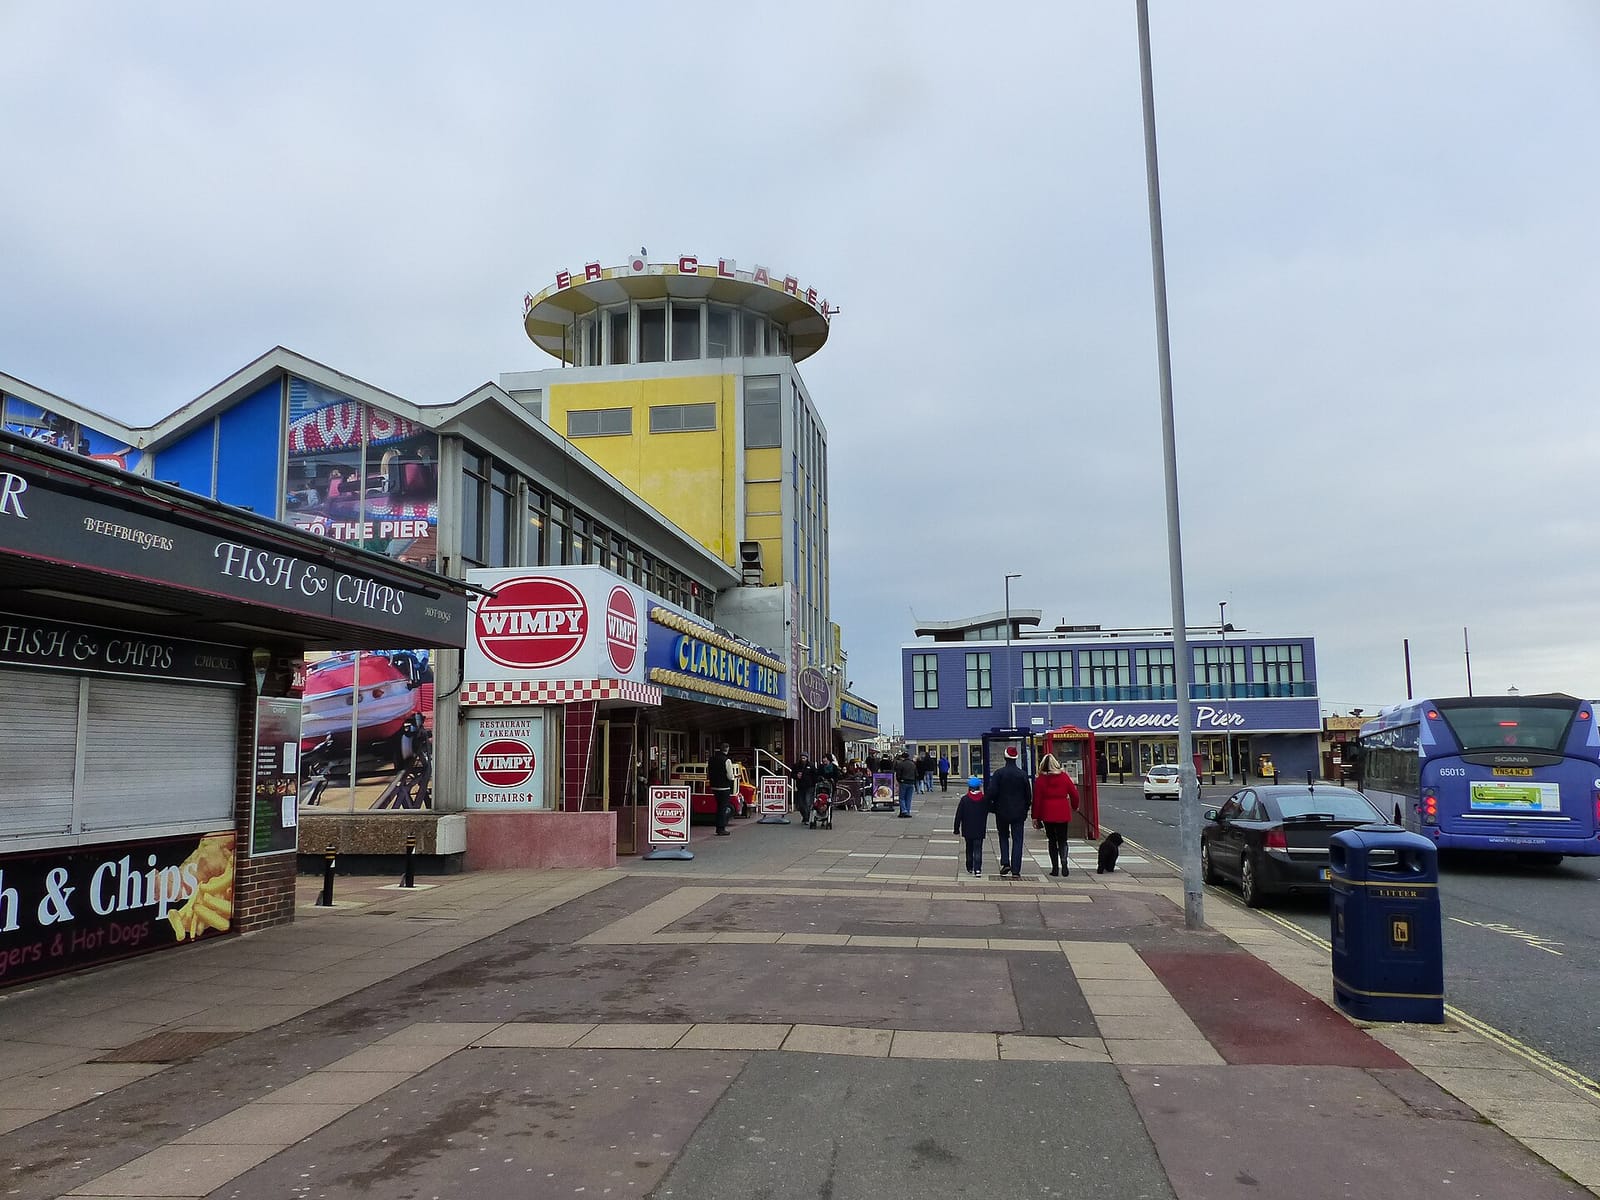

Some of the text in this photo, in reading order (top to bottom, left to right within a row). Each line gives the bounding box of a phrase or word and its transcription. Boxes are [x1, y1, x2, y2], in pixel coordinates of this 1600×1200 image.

[332, 522, 373, 539] THE
[380, 521, 429, 538] PIER
[84, 517, 174, 550] BEEFBURGERS
[214, 542, 298, 590] FISH
[300, 565, 328, 596] &
[336, 574, 405, 615] CHIPS
[480, 610, 583, 635] WIMPY
[607, 614, 637, 644] WIMPY
[0, 625, 70, 657] FISH
[73, 634, 98, 660] &
[106, 639, 173, 669] CHIPS
[678, 635, 779, 695] CLARENCE PIER
[480, 720, 532, 729] RESTAURANT
[1087, 706, 1245, 730] Clarence Pier
[489, 729, 531, 737] TAKEAWAY
[476, 757, 533, 770] WIMPY
[1440, 767, 1466, 777] 65013
[1495, 768, 1514, 776] YN54
[654, 790, 686, 800] OPEN
[764, 785, 785, 794] ATM
[475, 792, 525, 803] UPSTAIRS
[656, 809, 684, 817] WIMPY
[37, 867, 76, 926] &
[90, 854, 198, 921] Chips
[1379, 889, 1417, 898] LITTER
[50, 933, 63, 957] &
[72, 928, 105, 953] Hot
[109, 922, 150, 947] Dogs
